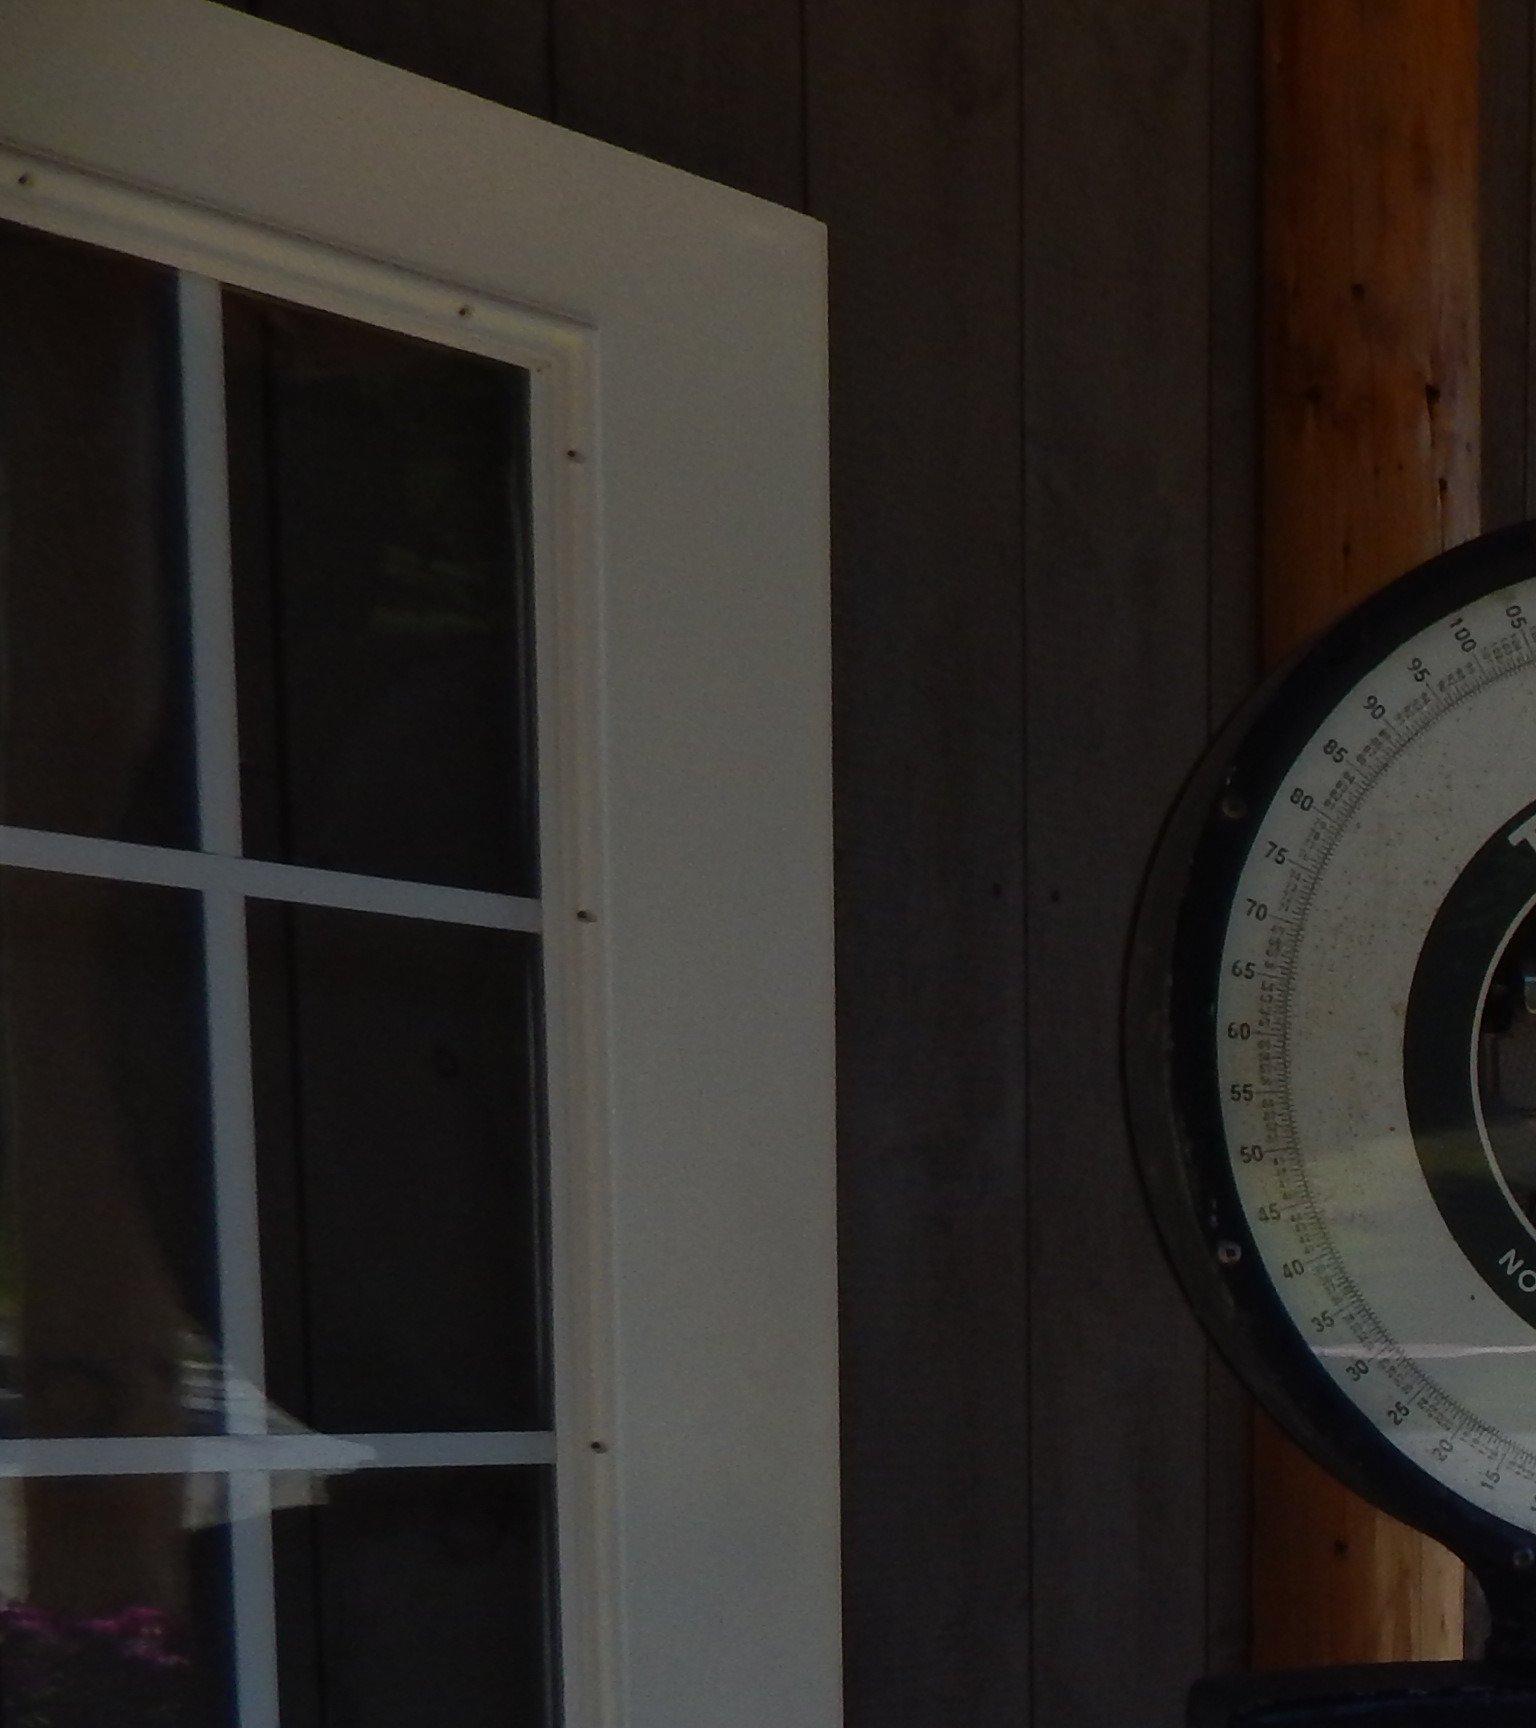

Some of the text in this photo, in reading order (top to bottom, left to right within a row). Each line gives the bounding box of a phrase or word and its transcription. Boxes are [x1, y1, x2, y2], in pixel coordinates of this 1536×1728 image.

[1449, 618, 1477, 654] 100
[1407, 657, 1431, 683] 95
[1363, 695, 1387, 720] 90
[1323, 739, 1348, 764] 85
[1289, 787, 1314, 812] 80
[1264, 841, 1288, 866] 75
[1245, 898, 1268, 922] 70
[1231, 960, 1256, 981] 65
[1227, 1023, 1252, 1041] 60
[1230, 1084, 1255, 1102] 55
[1240, 1145, 1264, 1164] 50
[1258, 1205, 1282, 1223] 45
[1283, 1259, 1306, 1280] 40
[1311, 1310, 1336, 1333] 35
[1346, 1359, 1370, 1383] 30
[1388, 1401, 1411, 1427] 25
[1481, 1471, 1501, 1491] 15
